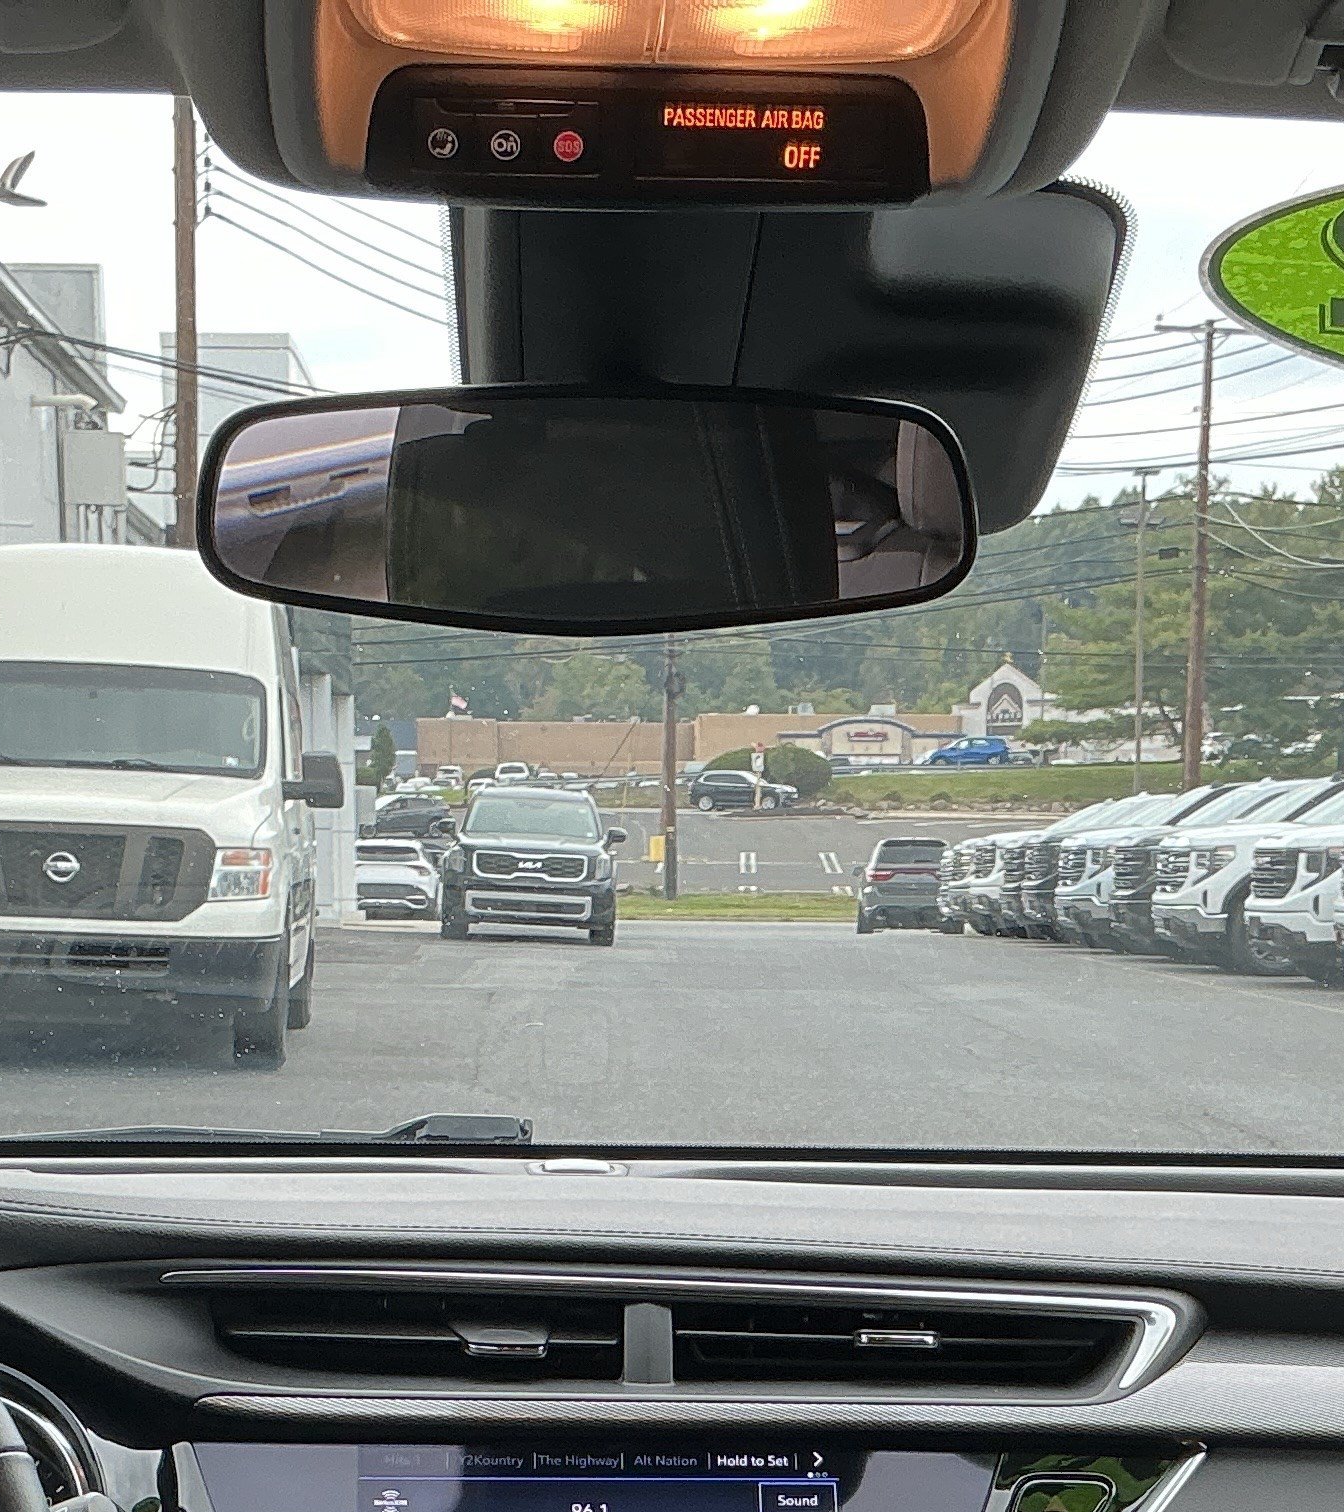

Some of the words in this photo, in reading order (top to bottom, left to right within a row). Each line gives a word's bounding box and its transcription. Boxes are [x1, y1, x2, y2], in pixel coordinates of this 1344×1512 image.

[663, 108, 755, 127] PASSENGER
[761, 109, 788, 128] AIR
[791, 110, 824, 129] BAG
[558, 139, 579, 155] SOS
[784, 146, 821, 169] OFF
[537, 1454, 562, 1467] The
[565, 1454, 619, 1470] Highway
[633, 1454, 652, 1467] Alt
[656, 1454, 698, 1467] Nation
[717, 1454, 747, 1467] Hold
[751, 1454, 765, 1467] to
[768, 1455, 790, 1467] Set
[777, 1494, 819, 1508] Sound
